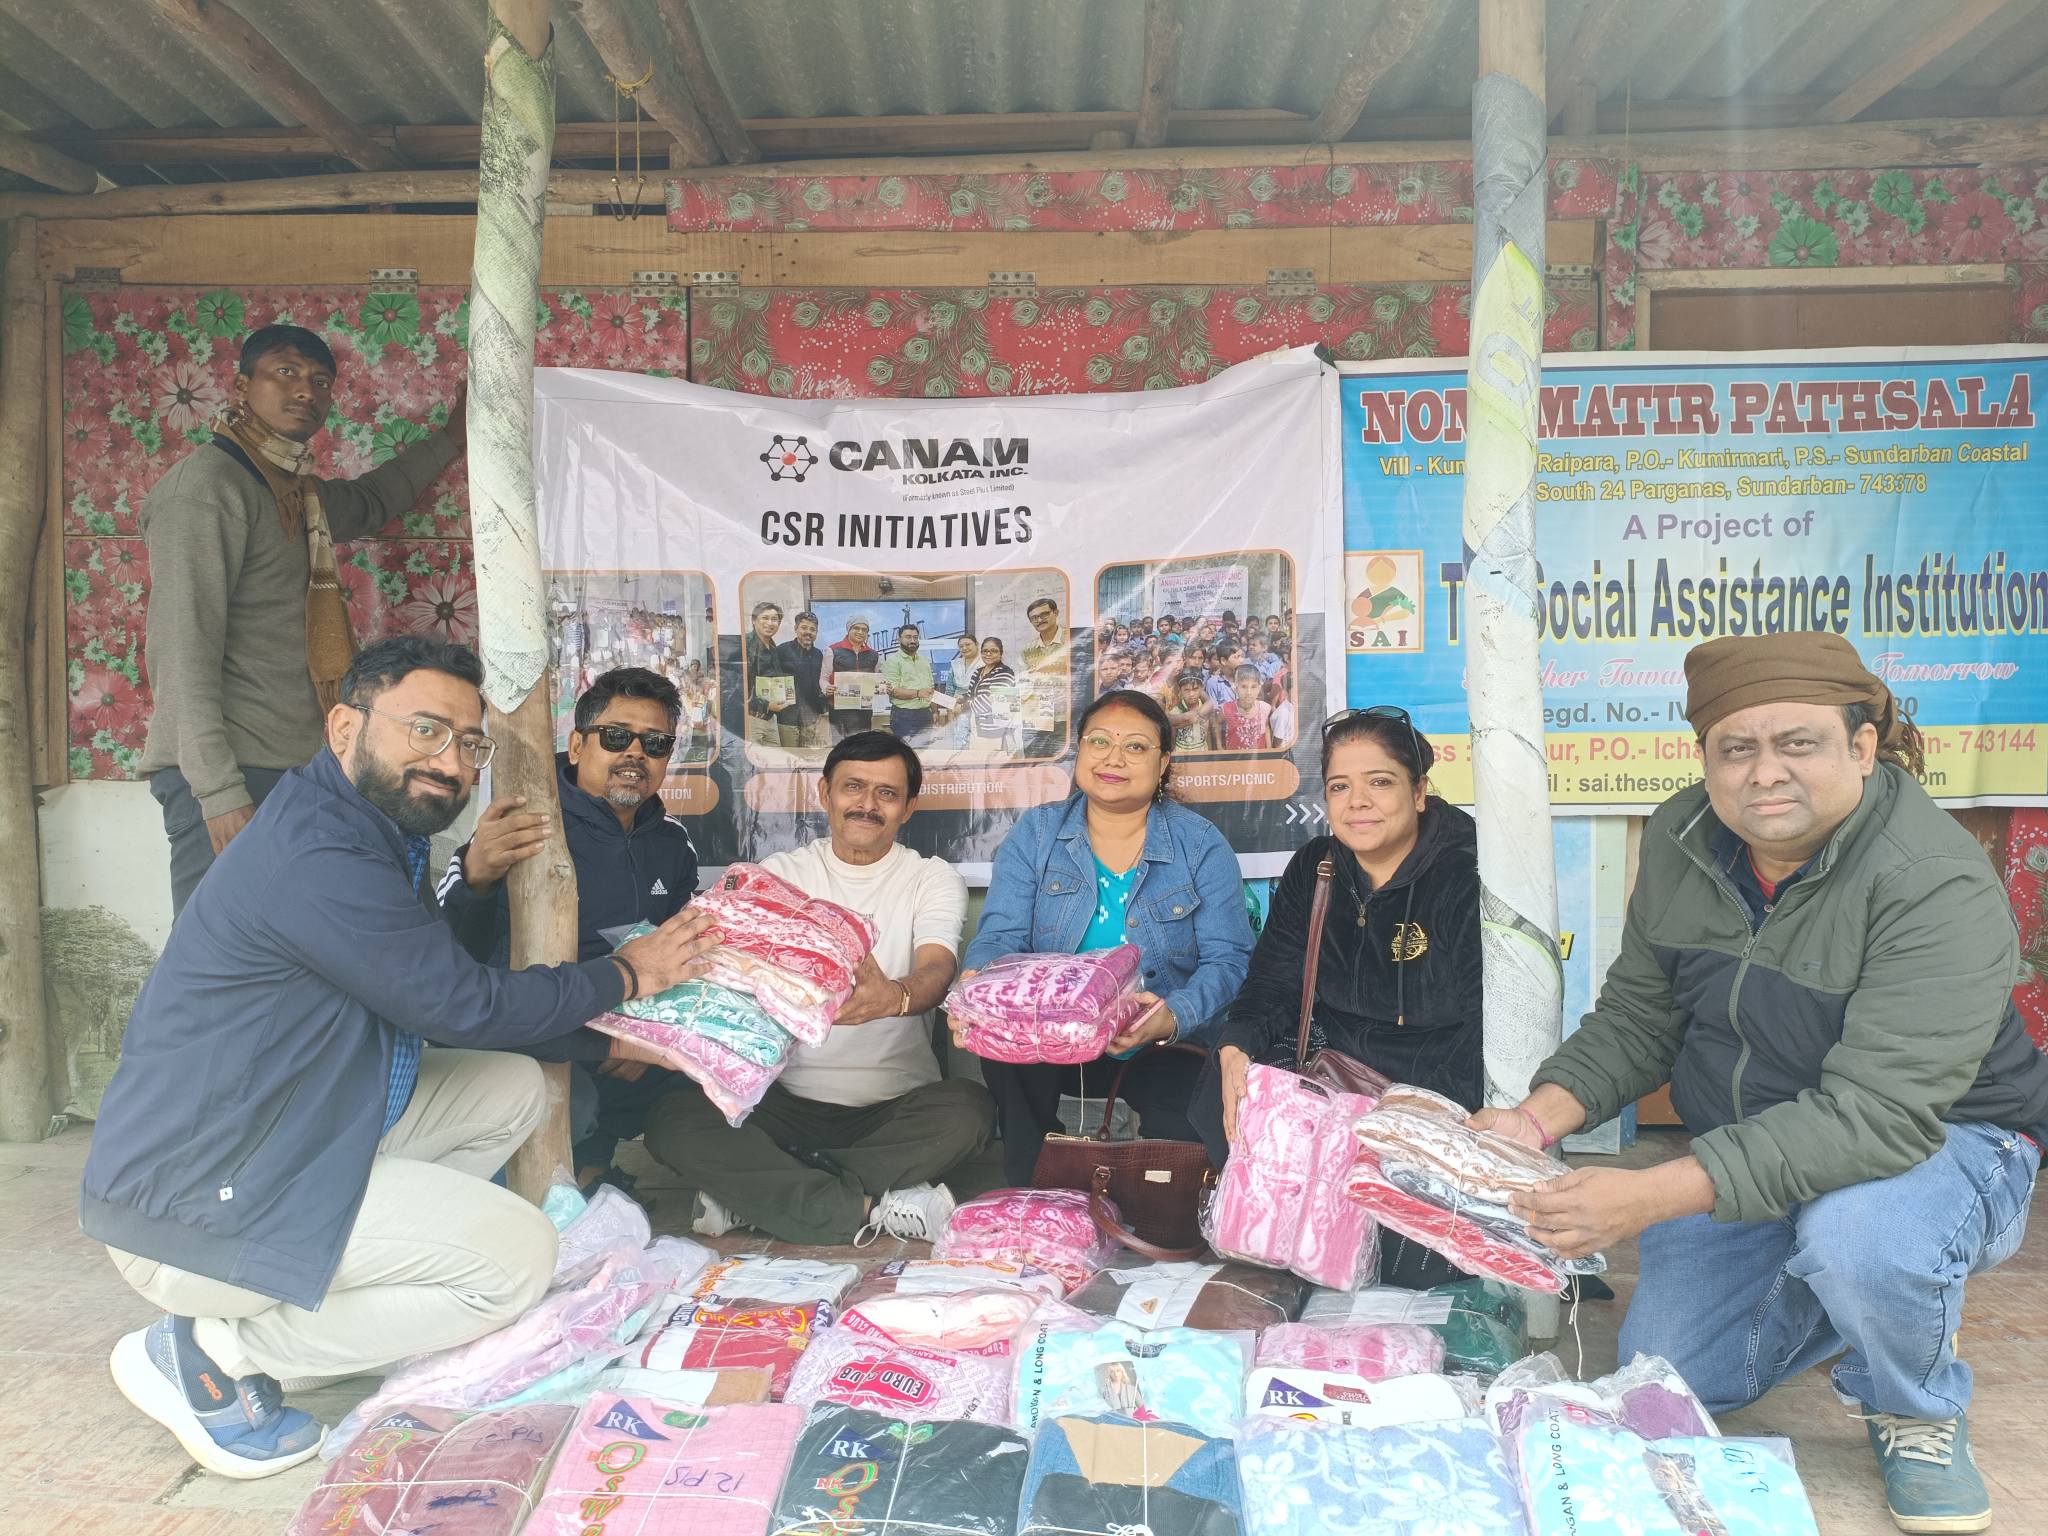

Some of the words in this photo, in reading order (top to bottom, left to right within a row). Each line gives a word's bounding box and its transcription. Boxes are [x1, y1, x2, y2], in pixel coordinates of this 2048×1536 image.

[1361, 388, 1467, 444] NON
[1537, 383, 1719, 438] MATIR
[1730, 373, 2036, 434] PATHSALA
[829, 437, 1029, 471] CANAM
[1379, 456, 1409, 475] Vill
[1537, 452, 1620, 475] Raipara,
[1626, 450, 1674, 469] P.O.-
[1678, 448, 1790, 469] Kumirmari,
[1795, 446, 1840, 465] P.S.-
[1845, 444, 1952, 465] Sundarban
[1957, 441, 2029, 462] Coastal
[902, 469, 984, 486] KOLKATA
[990, 466, 1029, 479] INC.
[990, 483, 1016, 493] Limited)
[1536, 480, 1595, 501] South
[1601, 480, 1624, 500] 24
[1631, 477, 1731, 502] Parganas,
[1737, 475, 1855, 497] Sundarban-
[1860, 473, 1928, 494] 743378
[761, 510, 825, 546] CSR
[837, 505, 1033, 549] INITIATIVES
[1622, 514, 1648, 541] A
[1657, 512, 1773, 545] Project
[1783, 510, 1815, 538] of
[1650, 556, 1851, 638] Assistance
[1863, 551, 2048, 636] Institution
[1871, 652, 2019, 682] Tomorrow
[1544, 703, 1597, 729] egd.
[1606, 702, 1660, 723] No.-
[1589, 736, 1647, 762] P.O.-
[1958, 728, 2036, 754] 743144
[919, 782, 1003, 795] DISTRIBUTION
[1177, 772, 1275, 787] SPORTS/PICNIC
[1034, 1346, 1045, 1374] LONG
[881, 1370, 926, 1398] EURO
[1268, 1389, 1305, 1406] RK
[383, 1417, 420, 1429] RK
[605, 1411, 644, 1435] RK
[1548, 1407, 1561, 1440] COAT
[831, 1439, 872, 1459] RK
[1551, 1443, 1567, 1477] LONG
[1557, 1481, 1569, 1491] &
